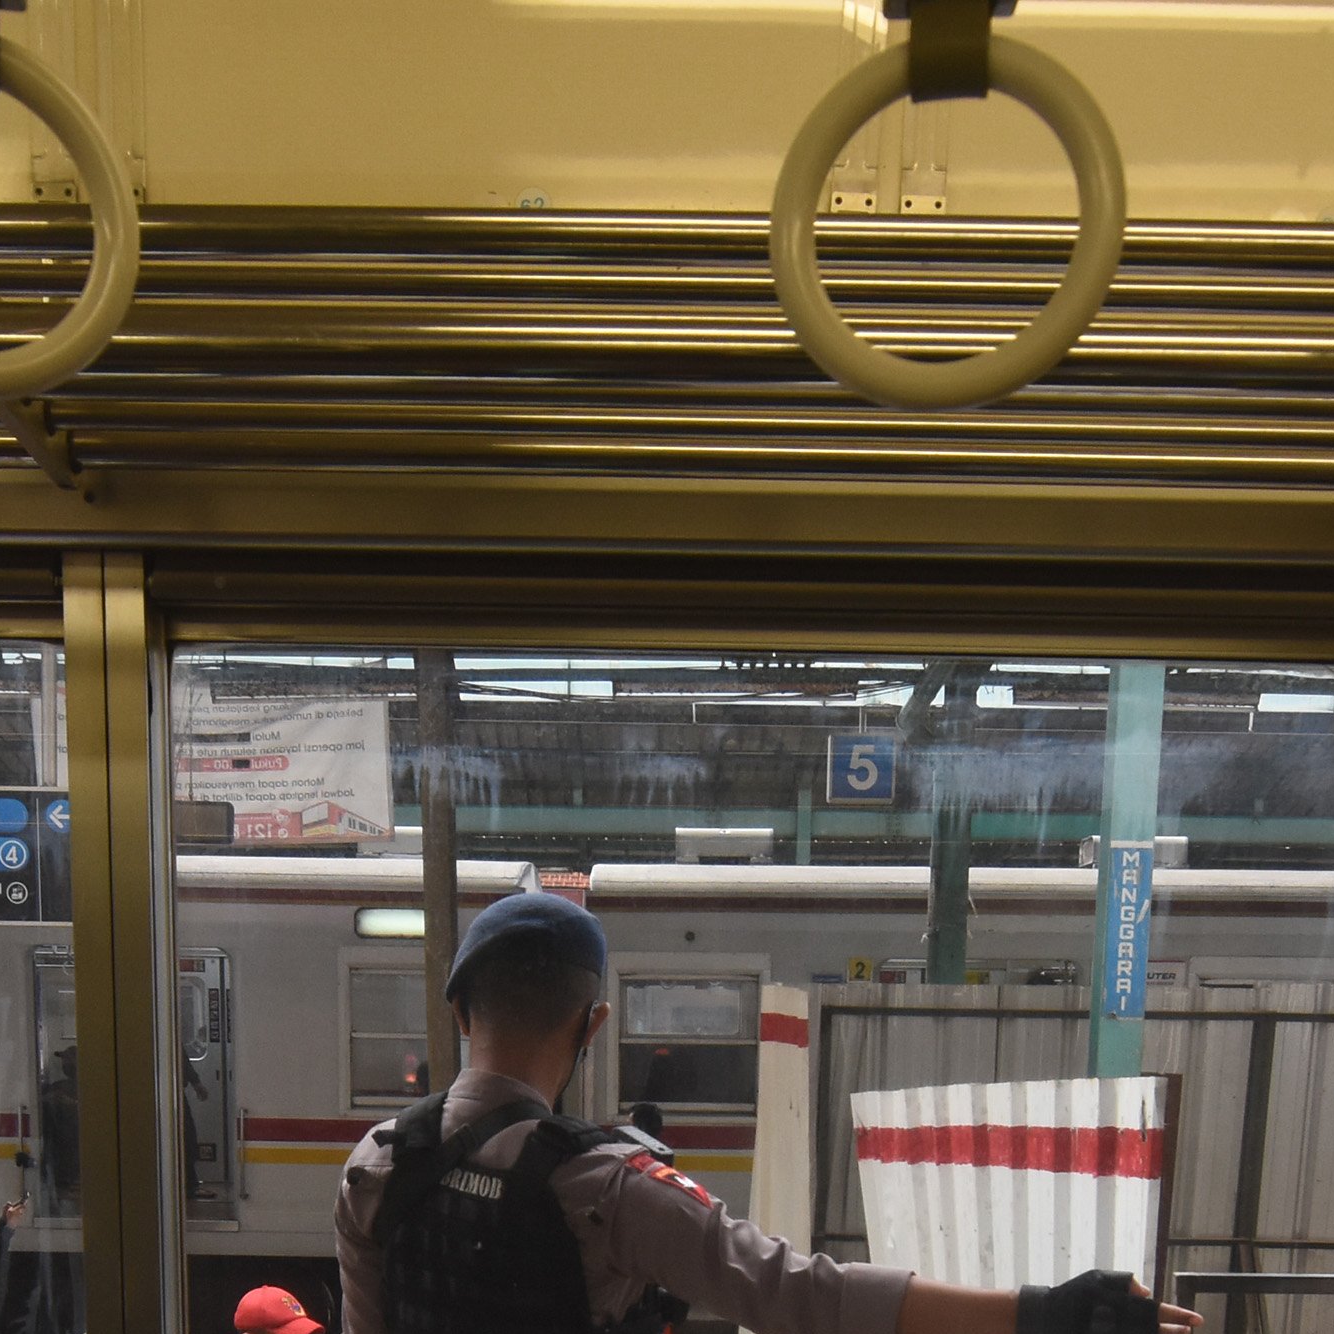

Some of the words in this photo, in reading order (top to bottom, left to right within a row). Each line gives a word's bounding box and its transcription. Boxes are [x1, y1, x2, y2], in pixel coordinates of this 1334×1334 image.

[847, 744, 878, 791] 5
[1116, 850, 1141, 1011] MANGGARAI
[855, 962, 866, 979] 2
[1147, 972, 1176, 980] UTER
